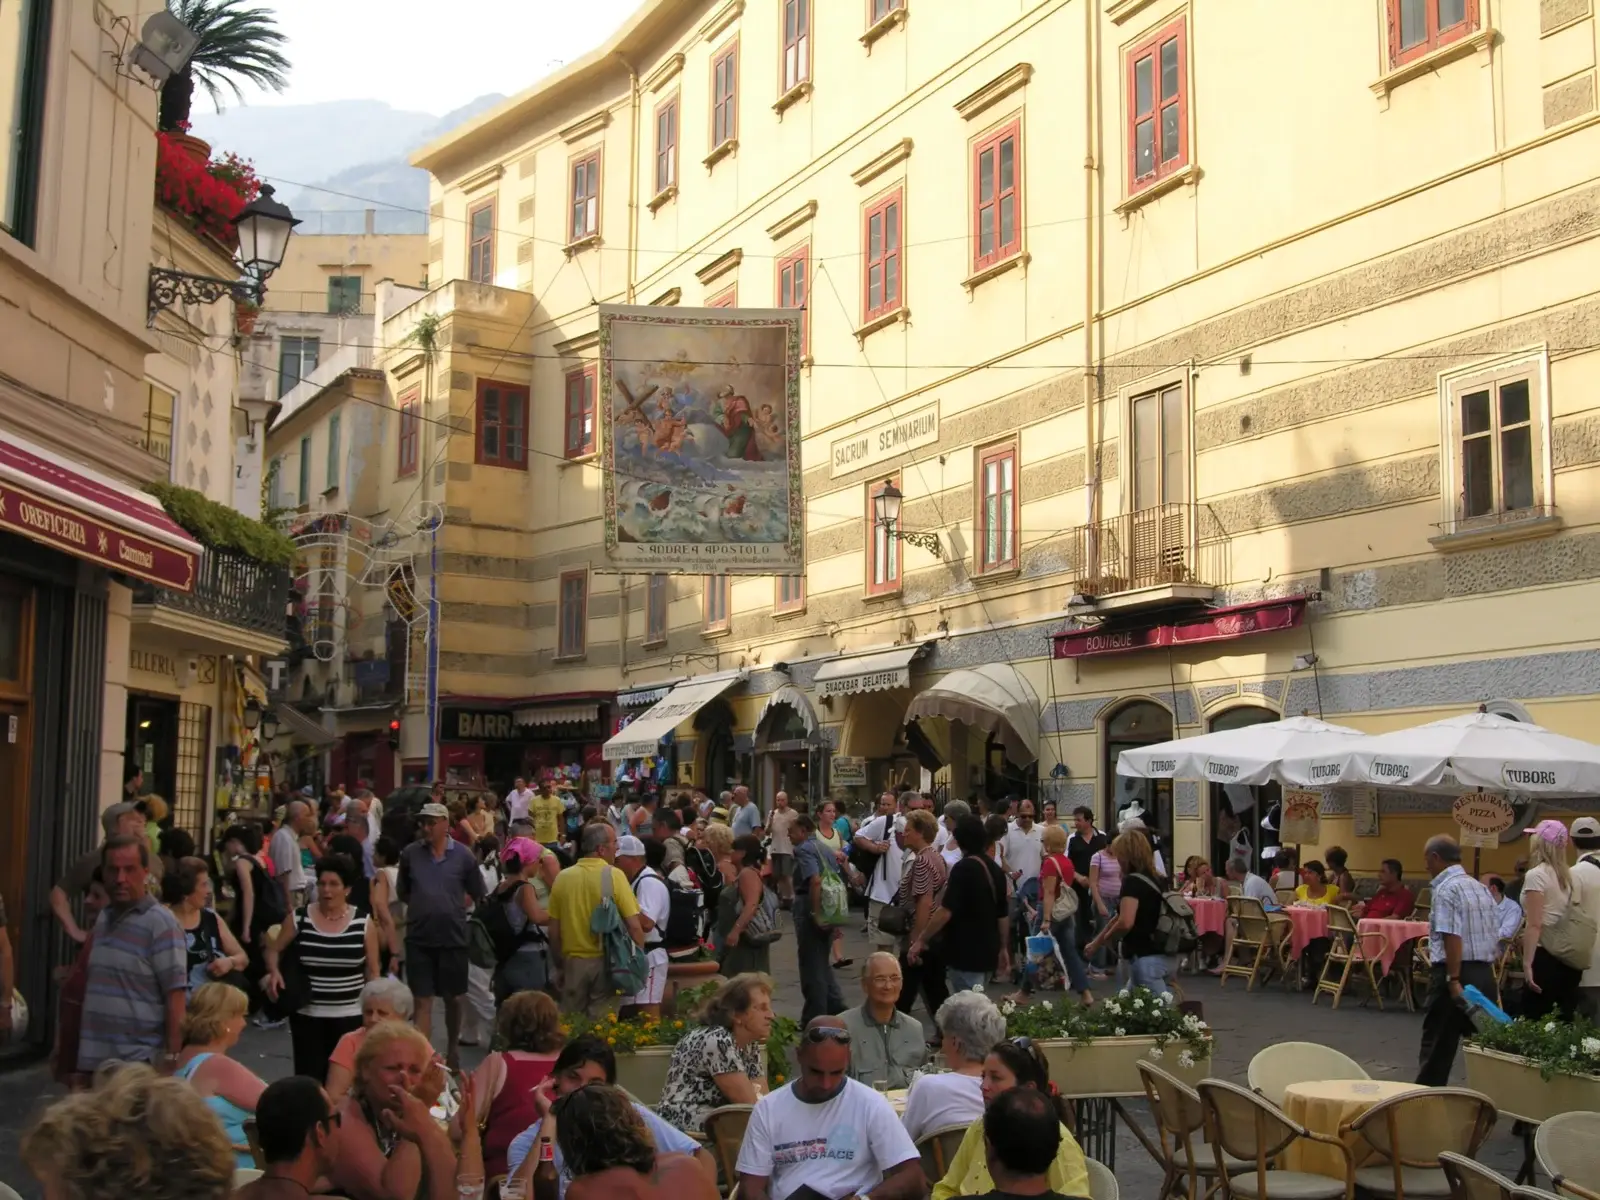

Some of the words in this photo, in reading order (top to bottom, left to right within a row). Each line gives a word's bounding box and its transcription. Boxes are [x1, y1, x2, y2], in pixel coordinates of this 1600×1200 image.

[835, 438, 869, 468] SACRUM
[879, 412, 936, 452] SEMINARIUM
[19, 501, 86, 546] OREFICERIA
[649, 545, 699, 555] ANDREA
[704, 545, 770, 555] APOSTOLO
[1086, 631, 1133, 651] BOUTIQUE
[266, 660, 287, 690] T
[862, 671, 899, 688] GELATERIA
[1151, 759, 1177, 773] TUBORG
[1208, 762, 1240, 778] TUBORG
[1311, 763, 1341, 779] TUBORG
[1374, 762, 1410, 779] TUBORG
[1505, 769, 1556, 785] TUBORG
[1454, 792, 1514, 818] RESTAURANT
[1468, 807, 1497, 819] PIZZA
